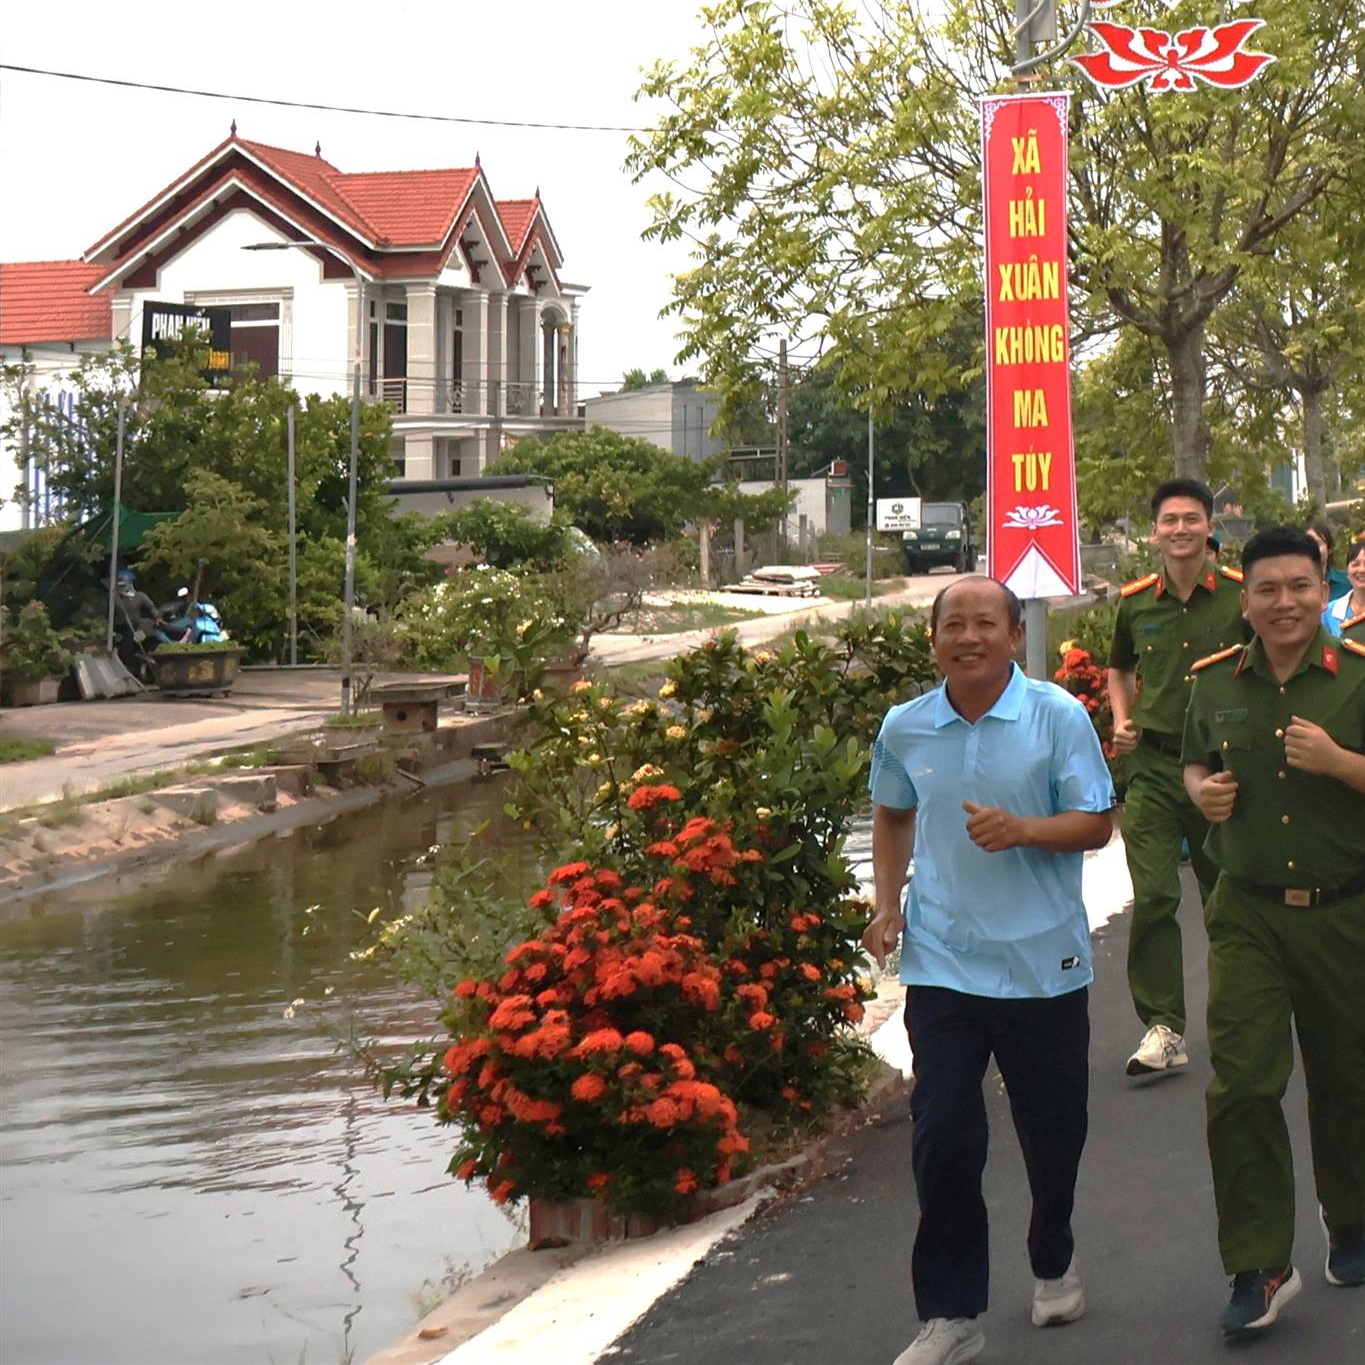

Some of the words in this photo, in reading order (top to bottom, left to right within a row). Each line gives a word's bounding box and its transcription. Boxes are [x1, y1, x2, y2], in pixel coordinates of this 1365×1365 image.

[1011, 128, 1041, 175] XÃ
[1008, 186, 1046, 238] HẢI
[999, 253, 1059, 302] XUÂN
[995, 318, 1064, 365] KHÔNG
[1013, 388, 1048, 428] MA
[1011, 444, 1052, 492] TÚY
